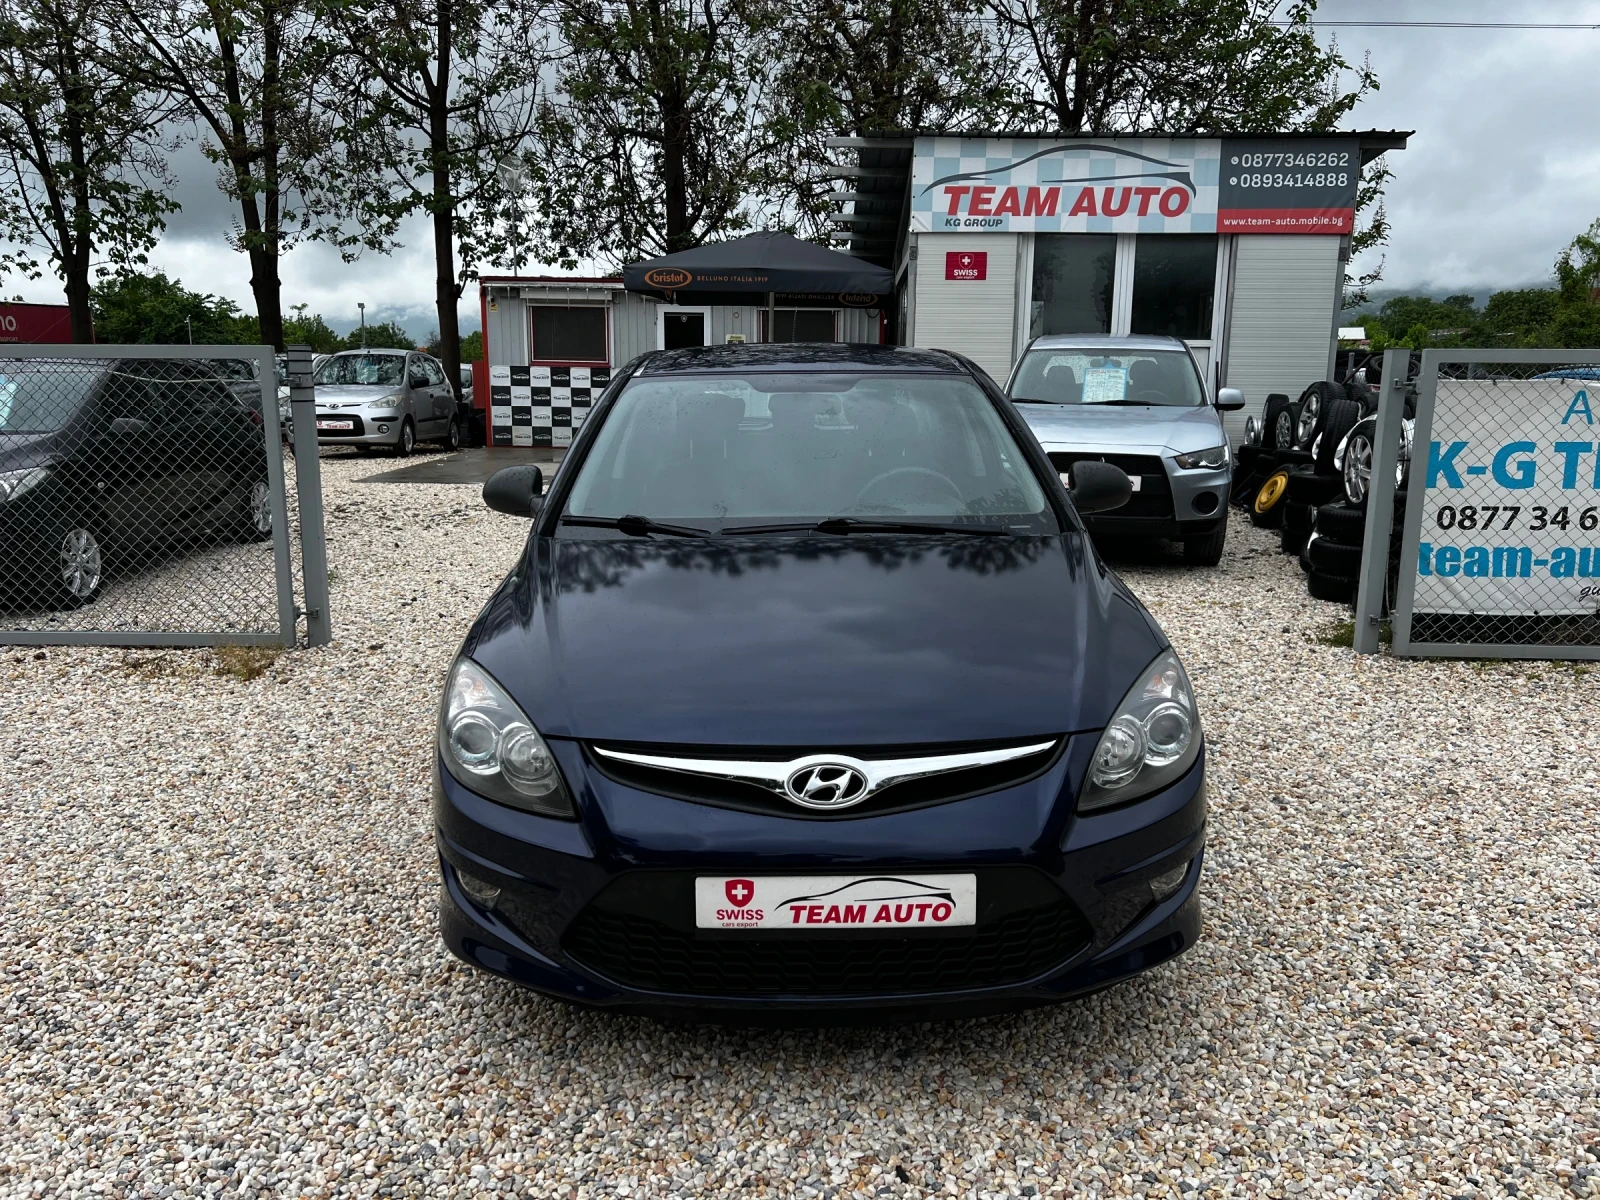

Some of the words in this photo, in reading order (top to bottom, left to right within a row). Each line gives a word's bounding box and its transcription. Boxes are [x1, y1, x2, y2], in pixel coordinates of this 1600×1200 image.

[1241, 152, 1349, 167] 0877346262
[1240, 173, 1348, 188] 0893414888
[943, 186, 1061, 217] TEAM
[1068, 186, 1190, 218] AUTO
[945, 218, 961, 227] KG
[964, 218, 1003, 228] GROUP
[1223, 216, 1343, 227] www.team-auto.mobile.bg
[1560, 390, 1600, 425] A
[1437, 505, 1521, 531] 0877
[1529, 506, 1571, 531] 34
[716, 909, 764, 921] SWISS
[789, 904, 867, 924] TEAM
[872, 902, 952, 924] AUTO
